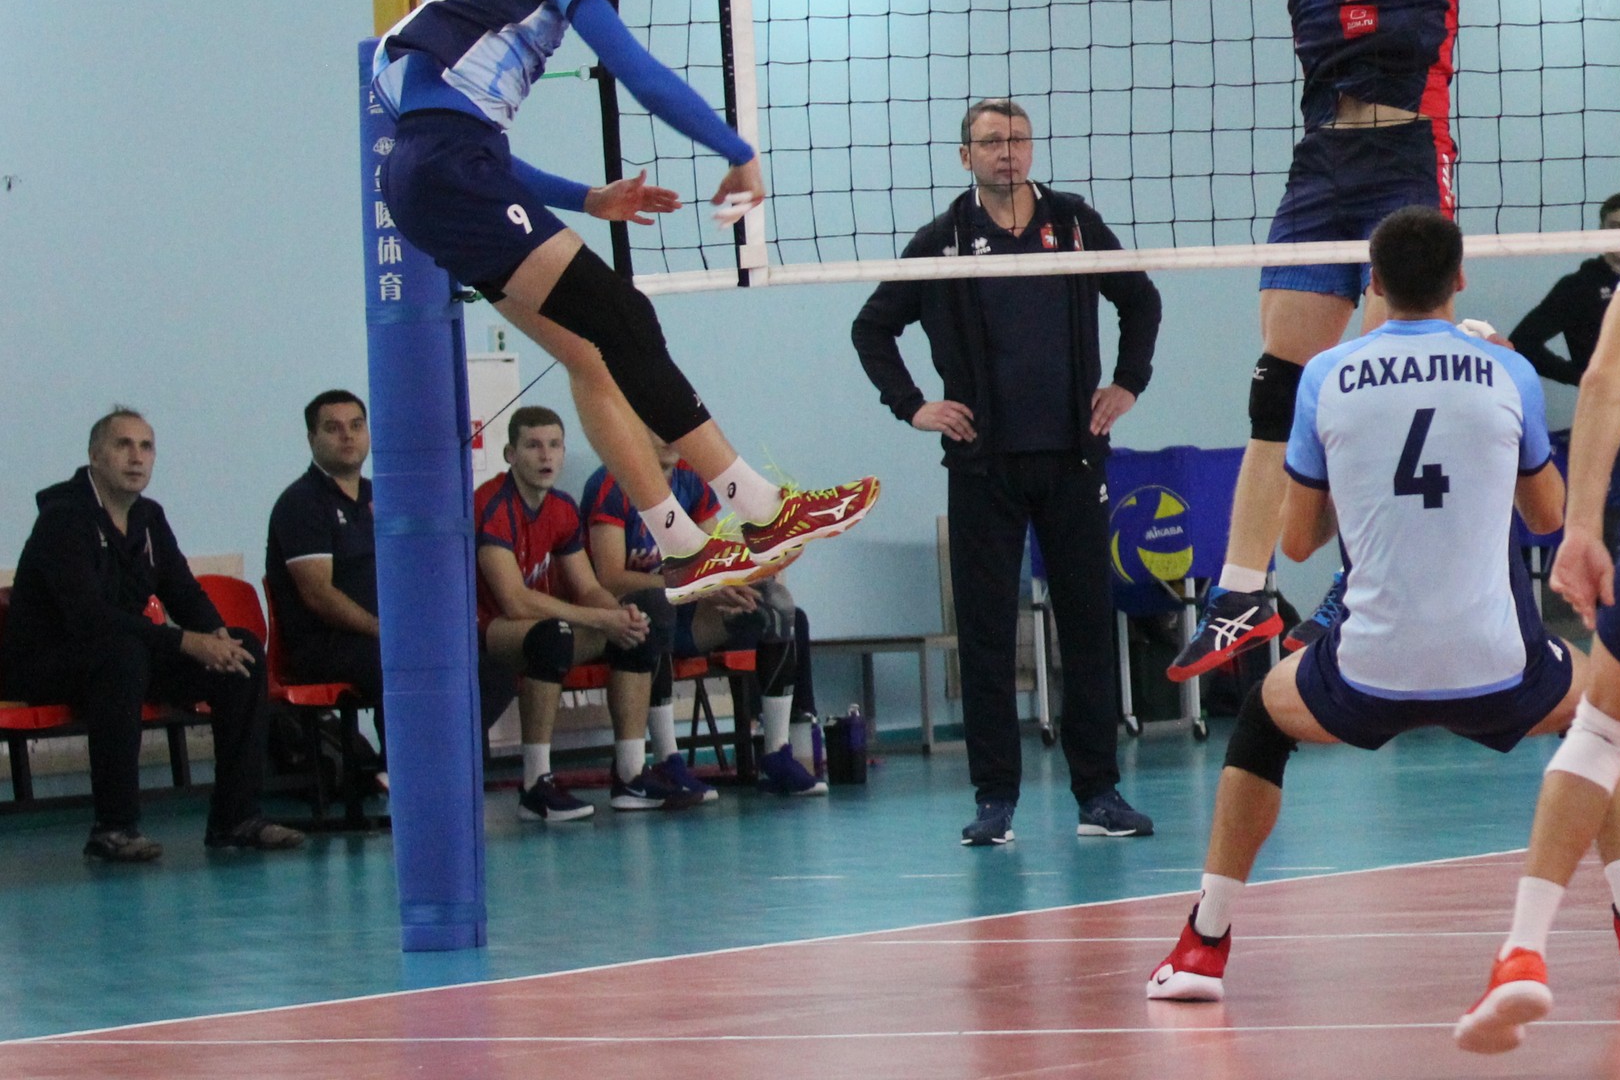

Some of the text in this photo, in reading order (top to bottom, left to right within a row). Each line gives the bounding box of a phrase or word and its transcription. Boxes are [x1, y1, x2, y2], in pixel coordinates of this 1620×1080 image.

[507, 203, 533, 235] 9
[1339, 354, 1494, 394] САХАЛИН
[1394, 407, 1450, 509] 4
